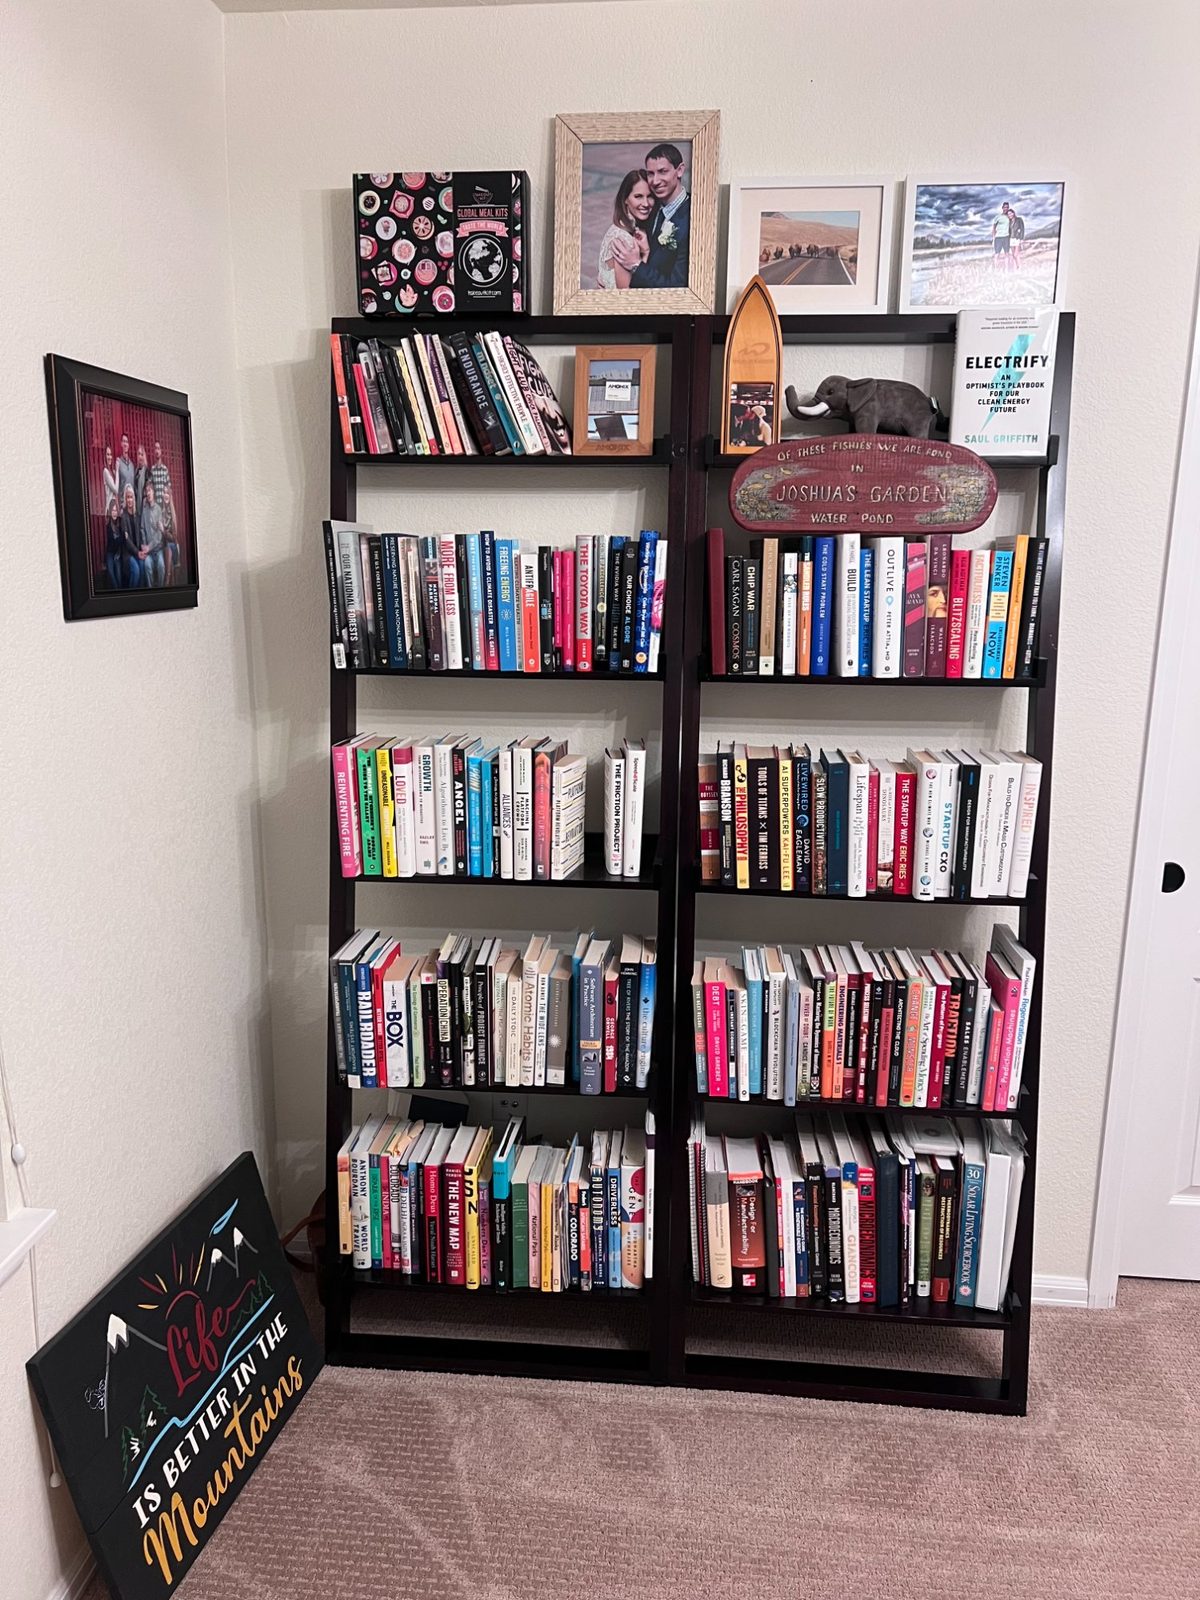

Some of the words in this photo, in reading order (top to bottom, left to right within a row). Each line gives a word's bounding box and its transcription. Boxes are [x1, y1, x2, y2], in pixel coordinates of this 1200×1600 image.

[457, 208, 478, 217] GLOBAL
[479, 208, 494, 217] MEAL
[495, 208, 508, 217] KITS
[965, 355, 1049, 369] ELECTRIFY
[458, 347, 489, 410] ENDURANCE
[778, 452, 791, 461] OF
[798, 445, 826, 457] THESE
[878, 443, 897, 452] WE
[904, 444, 923, 455] ARE
[964, 434, 990, 443] SAUL
[993, 434, 1038, 443] GRIFFITH
[851, 464, 863, 473] IN
[776, 484, 856, 502] JOSHUA'S
[871, 485, 949, 502] GARDEN
[811, 514, 847, 523] WATER
[861, 514, 893, 523] POND
[342, 554, 352, 569] OUR
[440, 540, 455, 569] MORE
[498, 546, 509, 575] FREEING
[579, 543, 589, 566] THE
[821, 556, 829, 572] COLD
[444, 572, 455, 595] FROM
[732, 560, 740, 585] CARL
[747, 566, 756, 588] CHIP
[820, 572, 828, 591] START
[847, 568, 857, 592] BUILD
[993, 556, 1002, 588] PINKER
[1001, 556, 1010, 588] STEVEN
[344, 570, 355, 607] NATIONAL
[501, 576, 511, 603] ENERGY
[524, 565, 535, 607] ANTIFRAGILE
[579, 569, 589, 610] TOYOTA
[445, 599, 456, 616] LESS
[732, 586, 741, 617] SAGAN
[747, 590, 756, 611] WAR
[819, 591, 827, 618] PROBLEM
[348, 608, 359, 642] FORESTS
[579, 612, 589, 635] WAY
[624, 616, 631, 625] AL
[948, 597, 964, 661] BLITZSCALING
[732, 622, 740, 659] COSMOS
[987, 630, 997, 659] NOW
[422, 754, 432, 792] GROWTH
[614, 763, 622, 779] THE
[757, 766, 768, 787] TOOLS
[782, 765, 788, 774] AI
[381, 770, 389, 807] UNREASONABLE
[395, 775, 407, 805] LOVED
[613, 780, 621, 816] FRICTION
[758, 787, 768, 796] OF
[800, 762, 809, 811] LIVEWIRED
[853, 775, 868, 815] Lifespan
[901, 778, 910, 794] THE
[337, 771, 350, 836] REINVENTING
[454, 780, 464, 825] ANGEL
[502, 793, 511, 829] ALLIANCES
[757, 797, 768, 819] TITANS
[900, 795, 909, 827] STARTUP
[1021, 782, 1037, 834] INSPIRED
[736, 795, 747, 855] PHILOSOPHY
[758, 831, 768, 843] TIM
[900, 828, 909, 846] WAY
[941, 802, 953, 850] STARTUP
[342, 837, 352, 857] FIRE
[758, 844, 768, 870] FERRISS
[795, 829, 803, 874] EAGLEMAN
[803, 838, 811, 865] DAVID
[899, 845, 908, 863] ERIC
[782, 865, 790, 880] LEE
[899, 863, 908, 880] RIES
[939, 851, 949, 874] CXO
[438, 980, 449, 1018] OPERATION
[523, 981, 535, 1022] Atomic
[712, 985, 720, 1005] DEBT
[740, 993, 748, 1016] SKIN
[642, 1007, 650, 1020] the
[944, 993, 961, 1058] TRACTION
[357, 991, 377, 1077] RAILROADER
[386, 1011, 404, 1048] BOX
[440, 1020, 449, 1041] CHINA
[640, 1021, 649, 1049] culture
[740, 1024, 748, 1052] GAME
[963, 1021, 972, 1045] SALES
[522, 1025, 534, 1062] Habits
[638, 1050, 648, 1076] engine
[959, 1046, 970, 1089] ENABLEMENT
[351, 1158, 360, 1198] BOURDAIN
[359, 1159, 368, 1198] ANTHONY
[390, 1164, 400, 1204] COLORADO
[429, 1170, 437, 1194] Homo
[448, 1180, 459, 1200] THE
[430, 1195, 438, 1213] Deus
[592, 1176, 604, 1231] AUTONOMY
[610, 1177, 618, 1226] DRIVERLESS
[628, 1187, 637, 1216] GENE
[748, 1196, 757, 1221] Design
[966, 1184, 980, 1210] SOLAR
[448, 1202, 459, 1226] NEW
[740, 1197, 753, 1255] Manufacturability
[749, 1221, 757, 1233] For
[964, 1210, 980, 1236] LIVING
[353, 1224, 361, 1253] TRAVEL
[361, 1225, 369, 1253] WORLD
[449, 1227, 460, 1250] MAP
[531, 1215, 539, 1241] National
[570, 1217, 578, 1261] COLORADO
[858, 1199, 876, 1279] MICROECONOMICS
[847, 1235, 858, 1289] GIANCOLI
[960, 1236, 977, 1283] SOURCEBOOK
[166, 1278, 257, 1398] Life
[132, 1484, 162, 1529] IS
[162, 1387, 232, 1489] BETTER
[231, 1357, 258, 1398] IN
[255, 1311, 289, 1360] THE
[143, 1354, 305, 1587] Mountains
